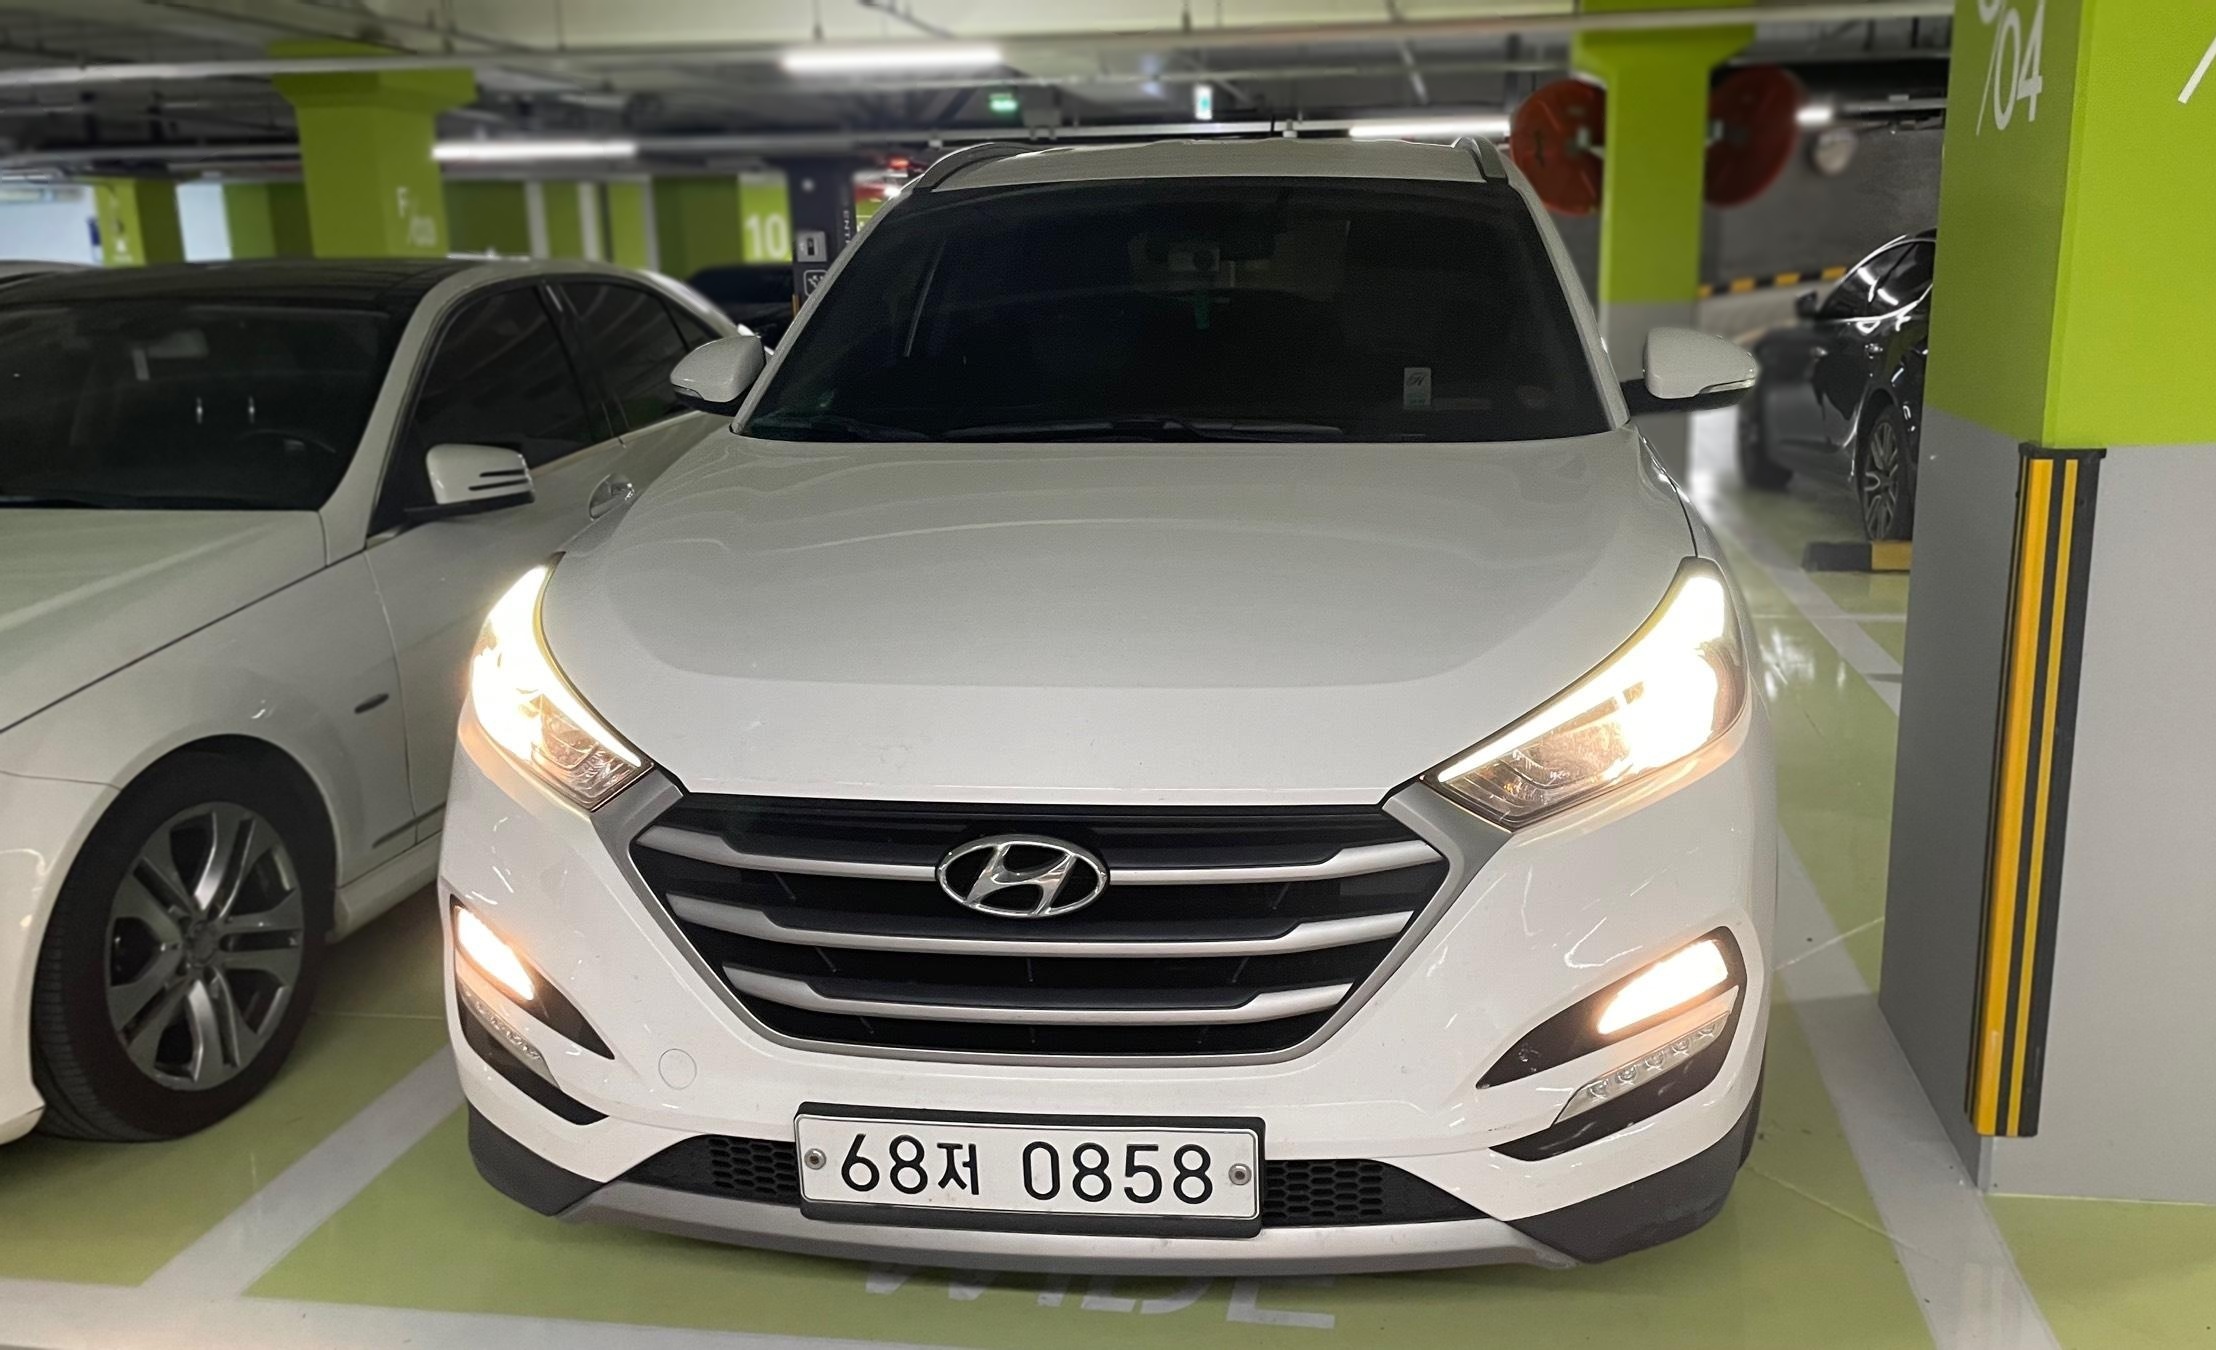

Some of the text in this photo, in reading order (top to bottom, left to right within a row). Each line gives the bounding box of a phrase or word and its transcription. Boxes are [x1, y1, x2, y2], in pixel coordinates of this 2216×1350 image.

[745, 213, 788, 259] 10
[841, 1133, 1213, 1205] 68저 0858
